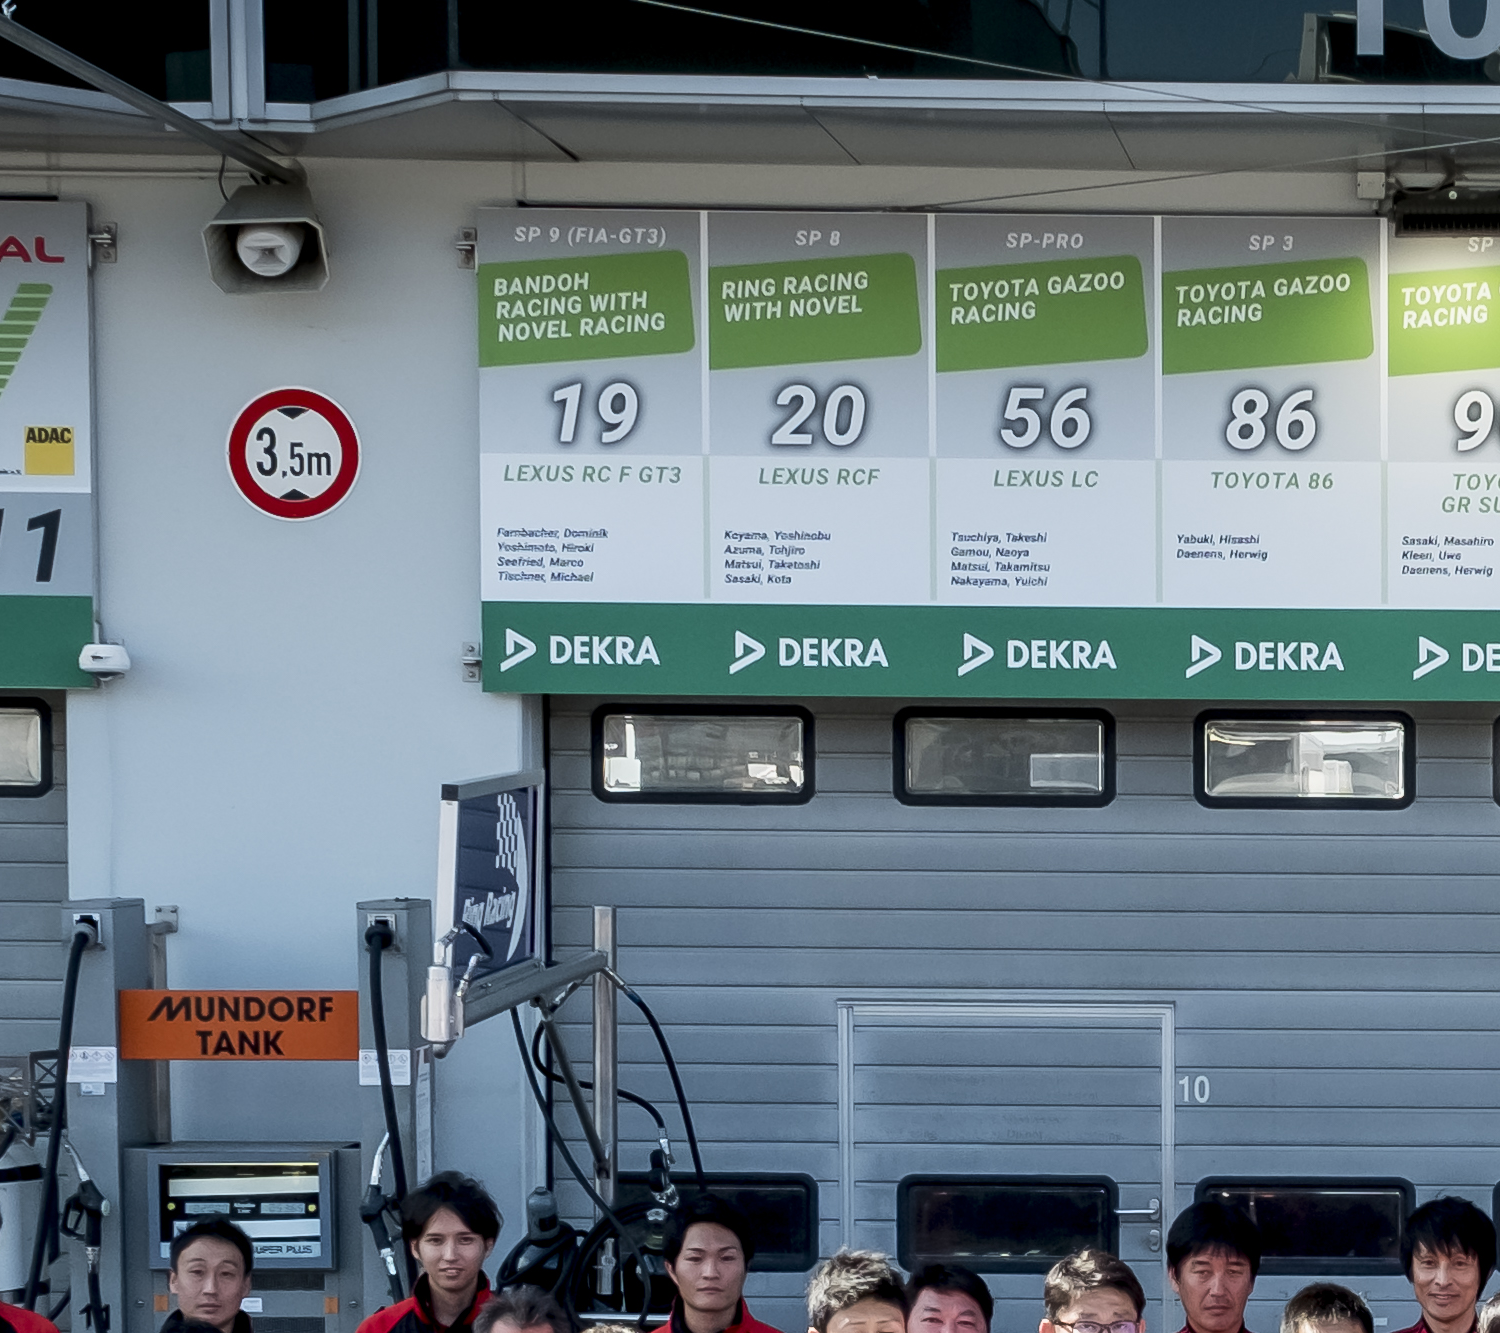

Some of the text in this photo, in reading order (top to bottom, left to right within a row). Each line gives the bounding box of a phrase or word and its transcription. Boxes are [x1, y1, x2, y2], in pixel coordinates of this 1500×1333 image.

[514, 227, 666, 247] SP 9 (FIA-GT3)
[1007, 233, 1083, 249] SP-PRO
[1468, 237, 1495, 253] SP
[494, 272, 589, 296] BANDOH
[722, 271, 868, 300] RING RACING
[950, 272, 1124, 301] TOYOTA GAZOO
[1402, 283, 1492, 306] TOYOTA
[496, 291, 647, 319] RACING WITH
[724, 295, 862, 322] WITH NOVEL
[951, 301, 1036, 325] RACING
[1403, 305, 1488, 329] RACING
[498, 314, 665, 341] NOVEL RACING
[553, 382, 640, 443] 19
[771, 384, 866, 446] 20
[1000, 386, 1091, 448] 56
[1225, 389, 1317, 450] 86
[504, 465, 681, 484] LEXUS RC F GT3
[759, 467, 880, 486] LEXUS RCF
[994, 469, 1097, 488] LEXUS LC
[1211, 471, 1334, 490] TOYOTA 86
[1442, 496, 1472, 514] GR
[550, 636, 659, 664] DEKRA
[148, 997, 333, 1021] MUNDORF
[197, 1029, 283, 1056] TANK
[1178, 1076, 1210, 1105] 10
